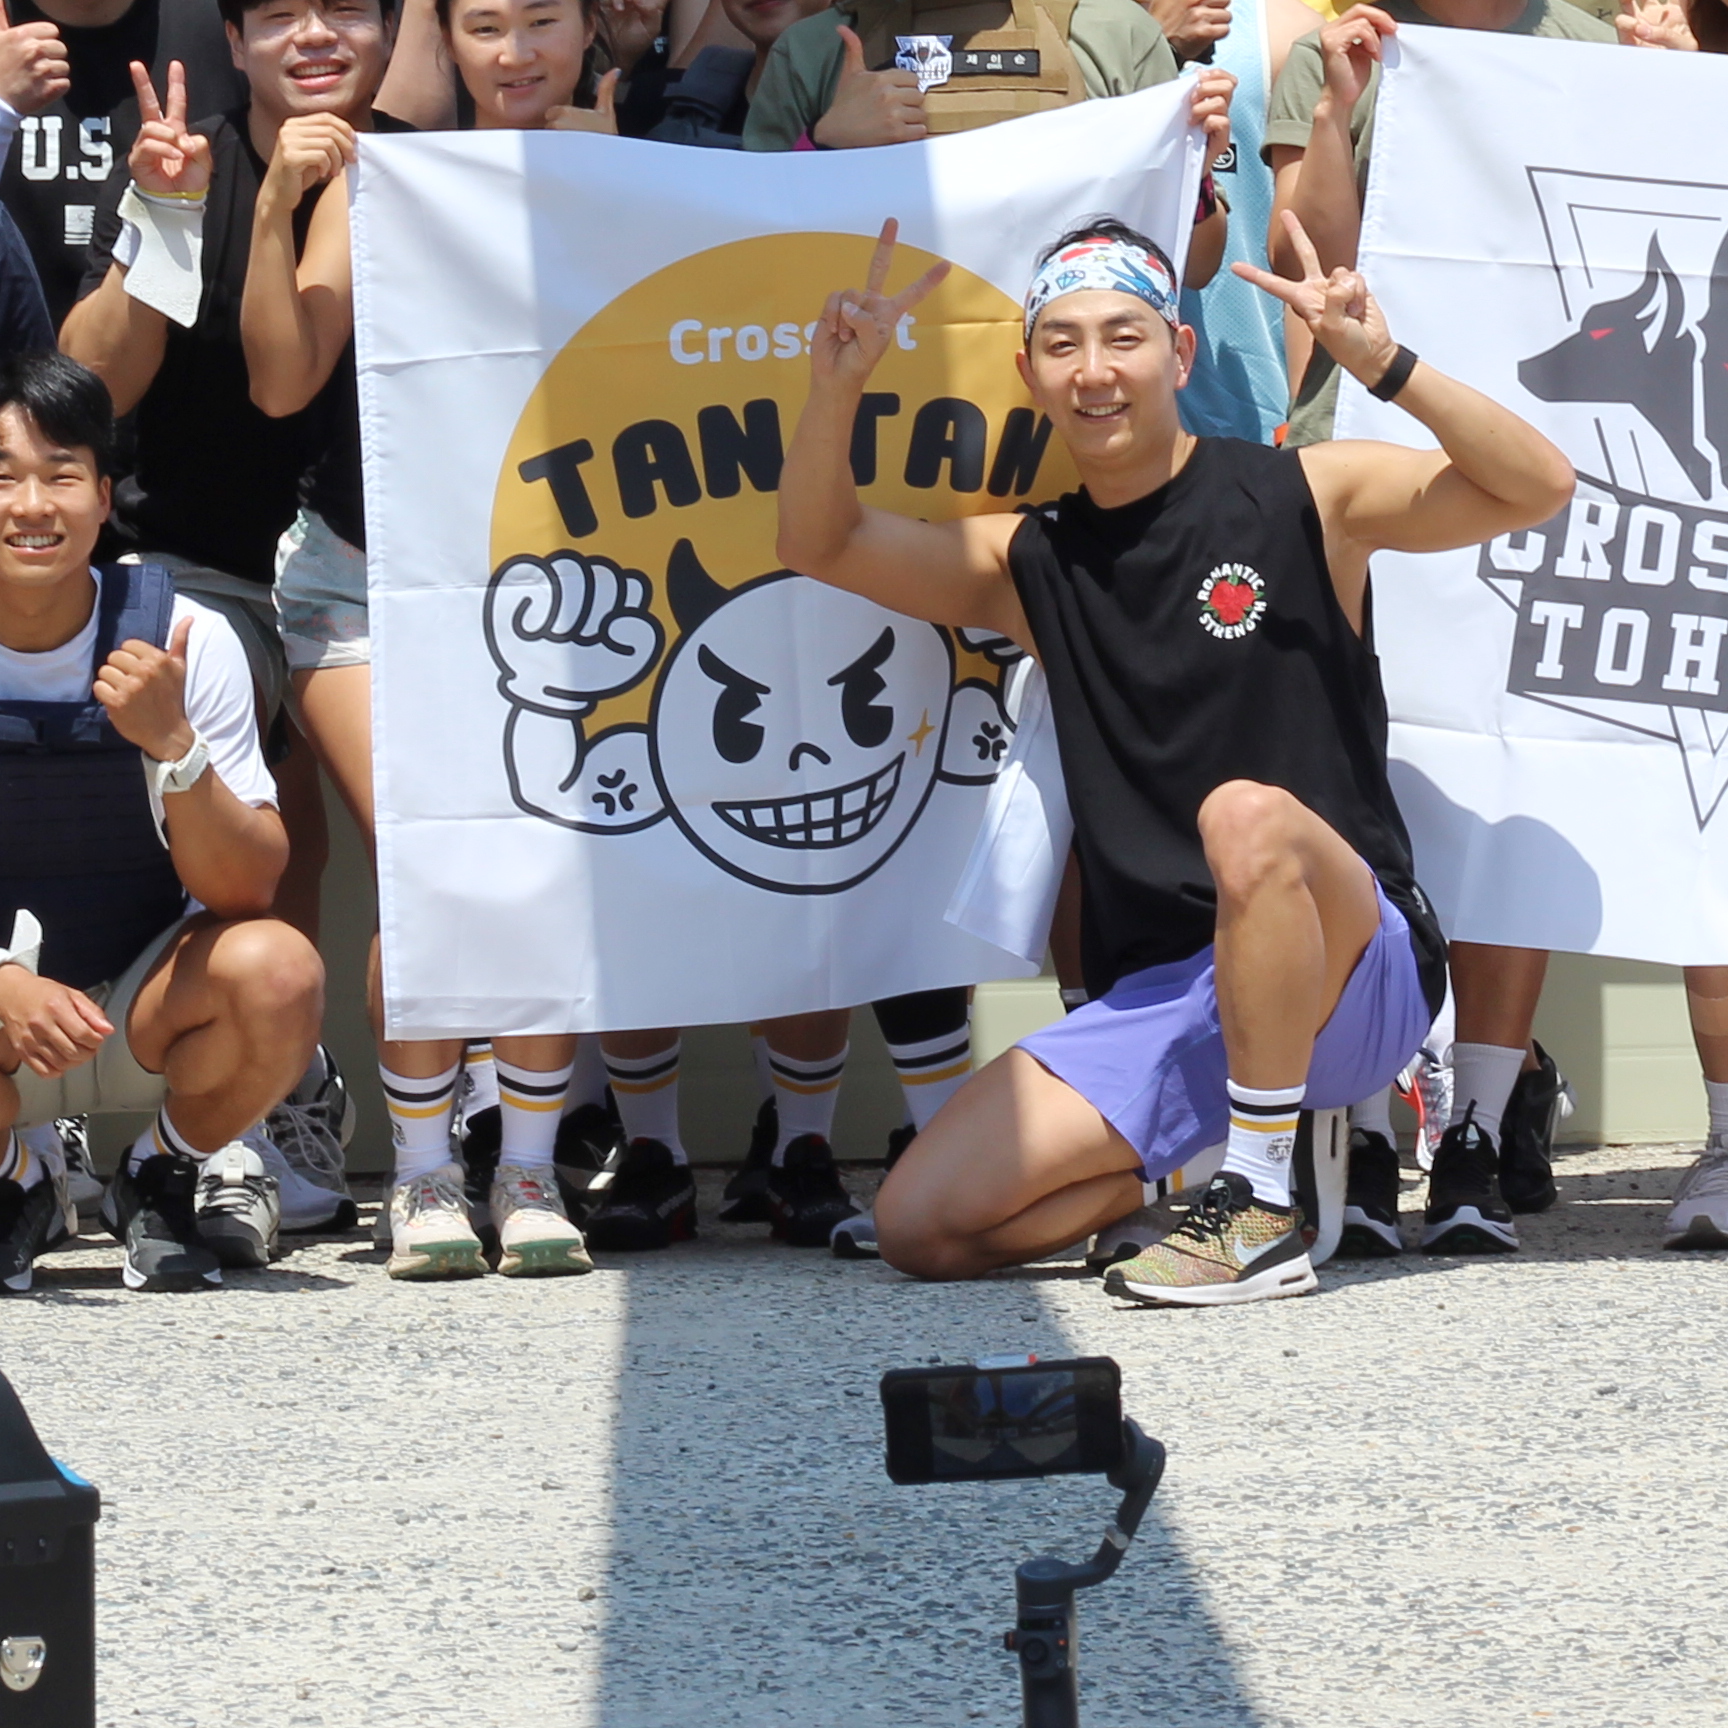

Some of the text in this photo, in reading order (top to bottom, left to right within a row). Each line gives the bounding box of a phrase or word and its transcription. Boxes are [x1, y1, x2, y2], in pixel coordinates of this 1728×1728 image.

[669, 312, 917, 365] Crost
[518, 398, 781, 539] TAN
[1196, 562, 1265, 601] ROMANTIC
[1198, 600, 1268, 640] STRENGTH
